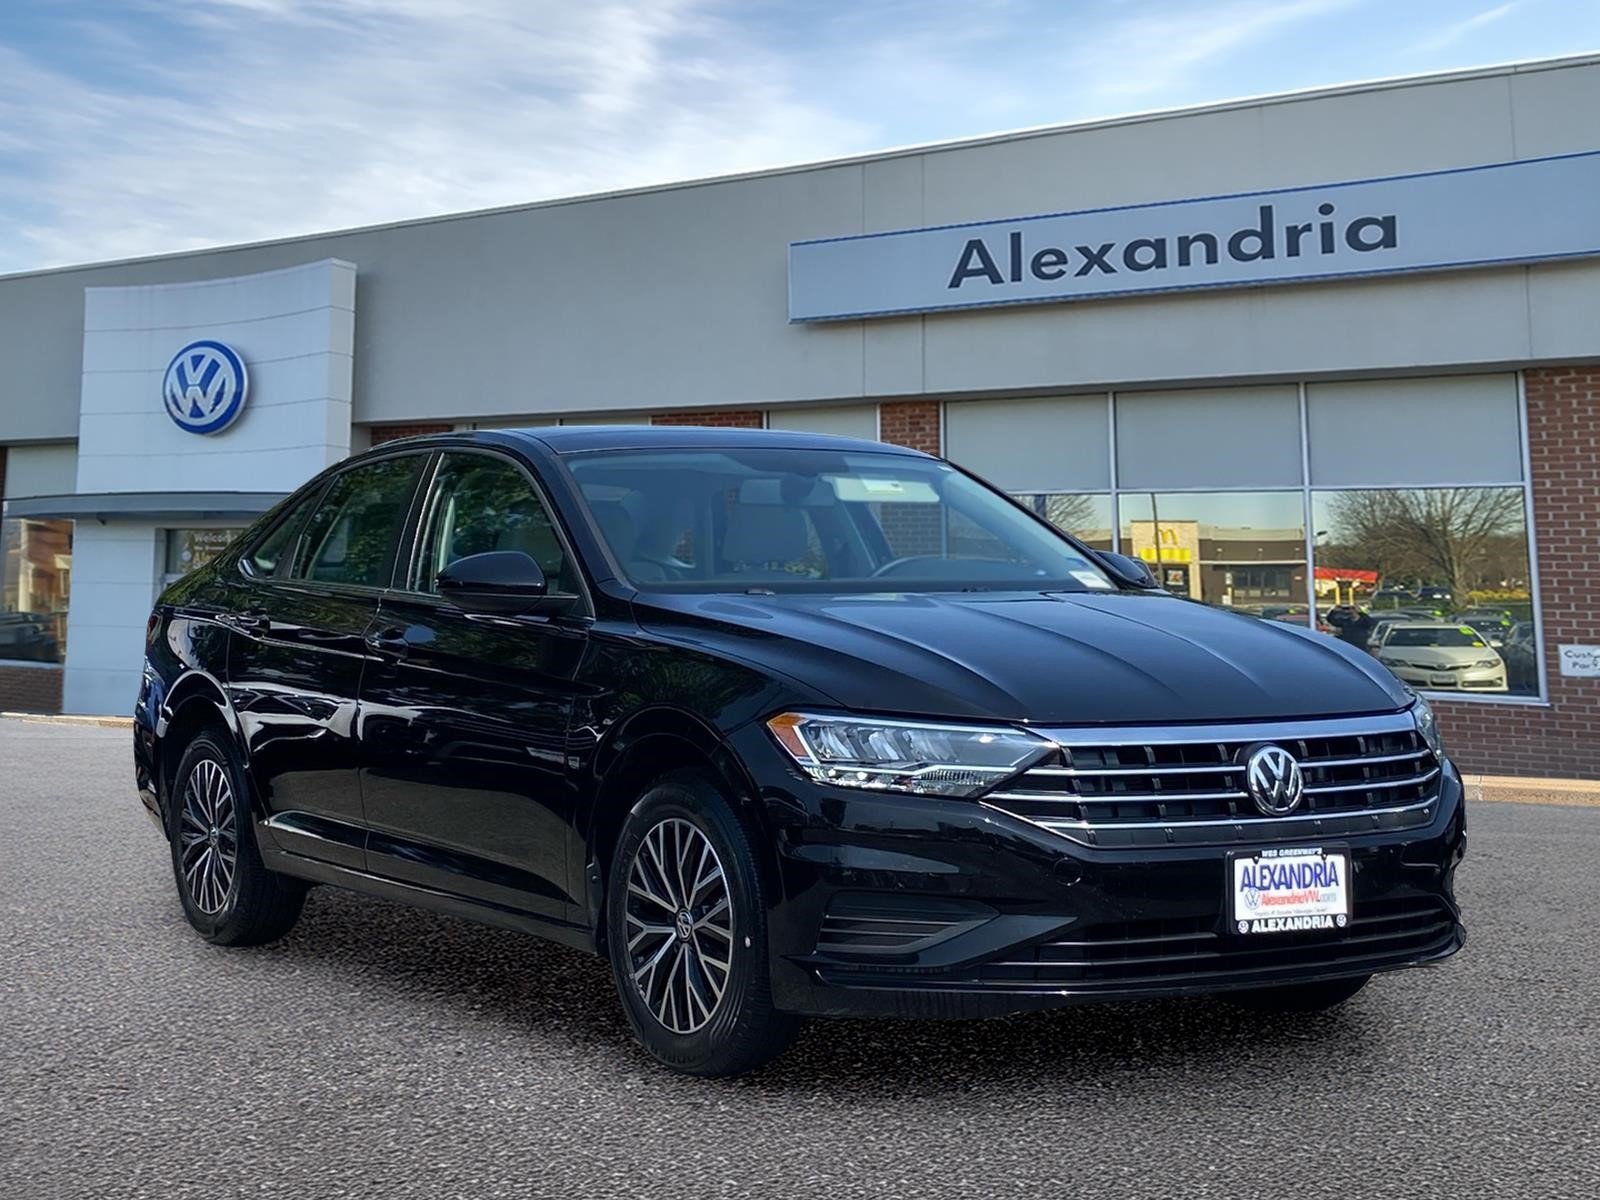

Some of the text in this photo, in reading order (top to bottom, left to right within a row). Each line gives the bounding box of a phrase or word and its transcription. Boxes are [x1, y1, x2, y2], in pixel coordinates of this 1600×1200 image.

[947, 203, 1398, 289] Alexandria
[165, 345, 237, 427] VW
[1240, 861, 1339, 892] ALEXANDRIA
[1251, 915, 1334, 933] ALEXANDRIA
